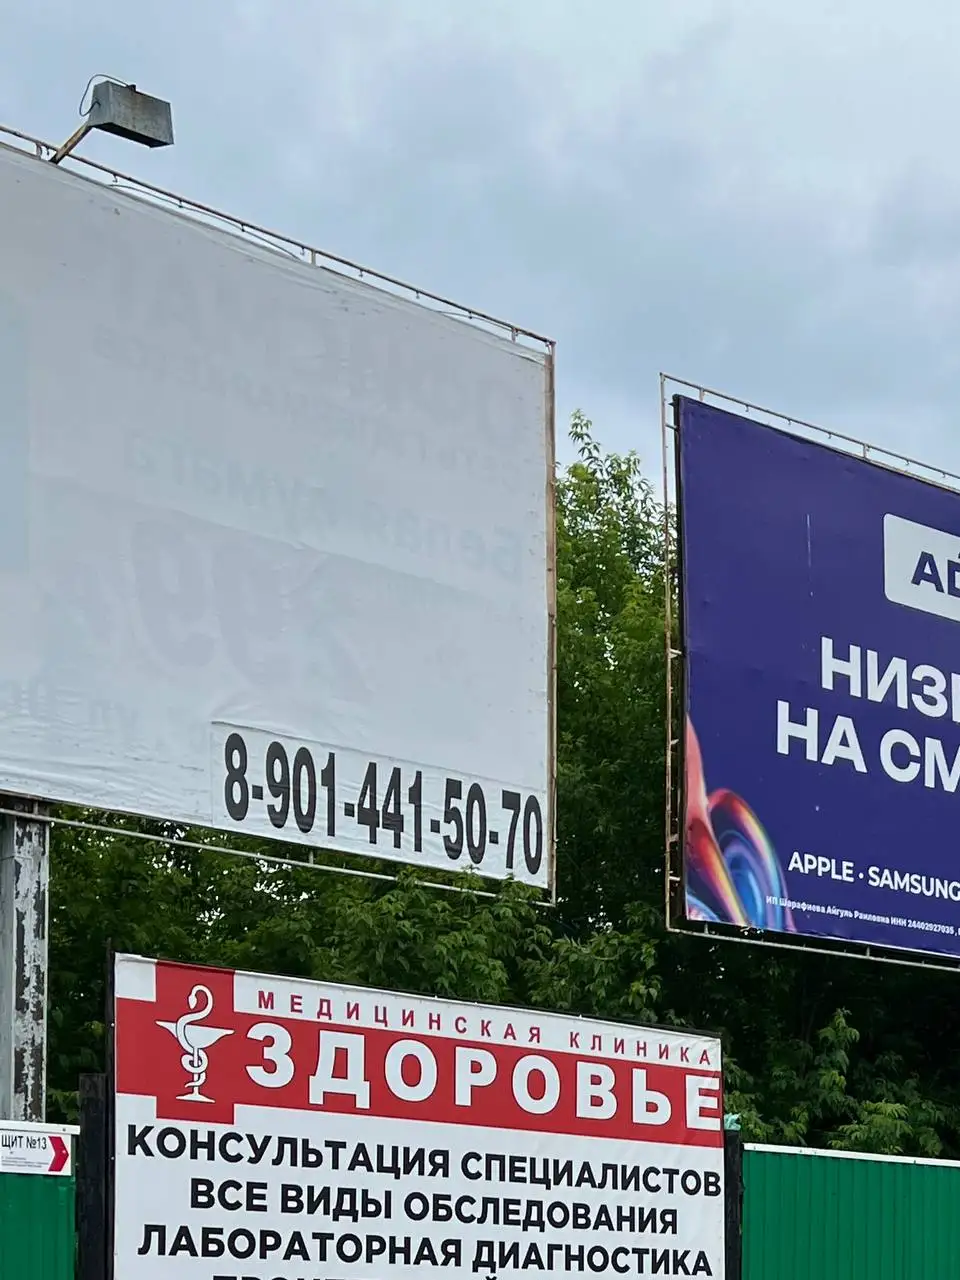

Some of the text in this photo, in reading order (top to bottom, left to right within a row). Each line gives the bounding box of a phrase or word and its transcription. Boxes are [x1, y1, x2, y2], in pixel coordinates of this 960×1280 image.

[776, 700, 867, 774] НА
[224, 732, 543, 875] 8-901-441-50-70
[788, 851, 854, 884] APPLE
[826, 906, 854, 919] Айгуль
[258, 990, 712, 1066] МЕДИЦИНСКАЯ КЛИНИКА
[245, 1022, 722, 1132] ЗДОРОВЬЕ
[2, 1134, 47, 1150] ЩИТ №13
[127, 1125, 722, 1198] КОНСУЛЬТАЦИЯ СПЕЦИАЛИСТОВ
[190, 1178, 678, 1235] ВСЕ ВИДЫ ОБСЛЕДОВАНИЯ
[138, 1224, 713, 1277] ЛАБОРАТОРНАЯ ДИАГНОСТИКА
